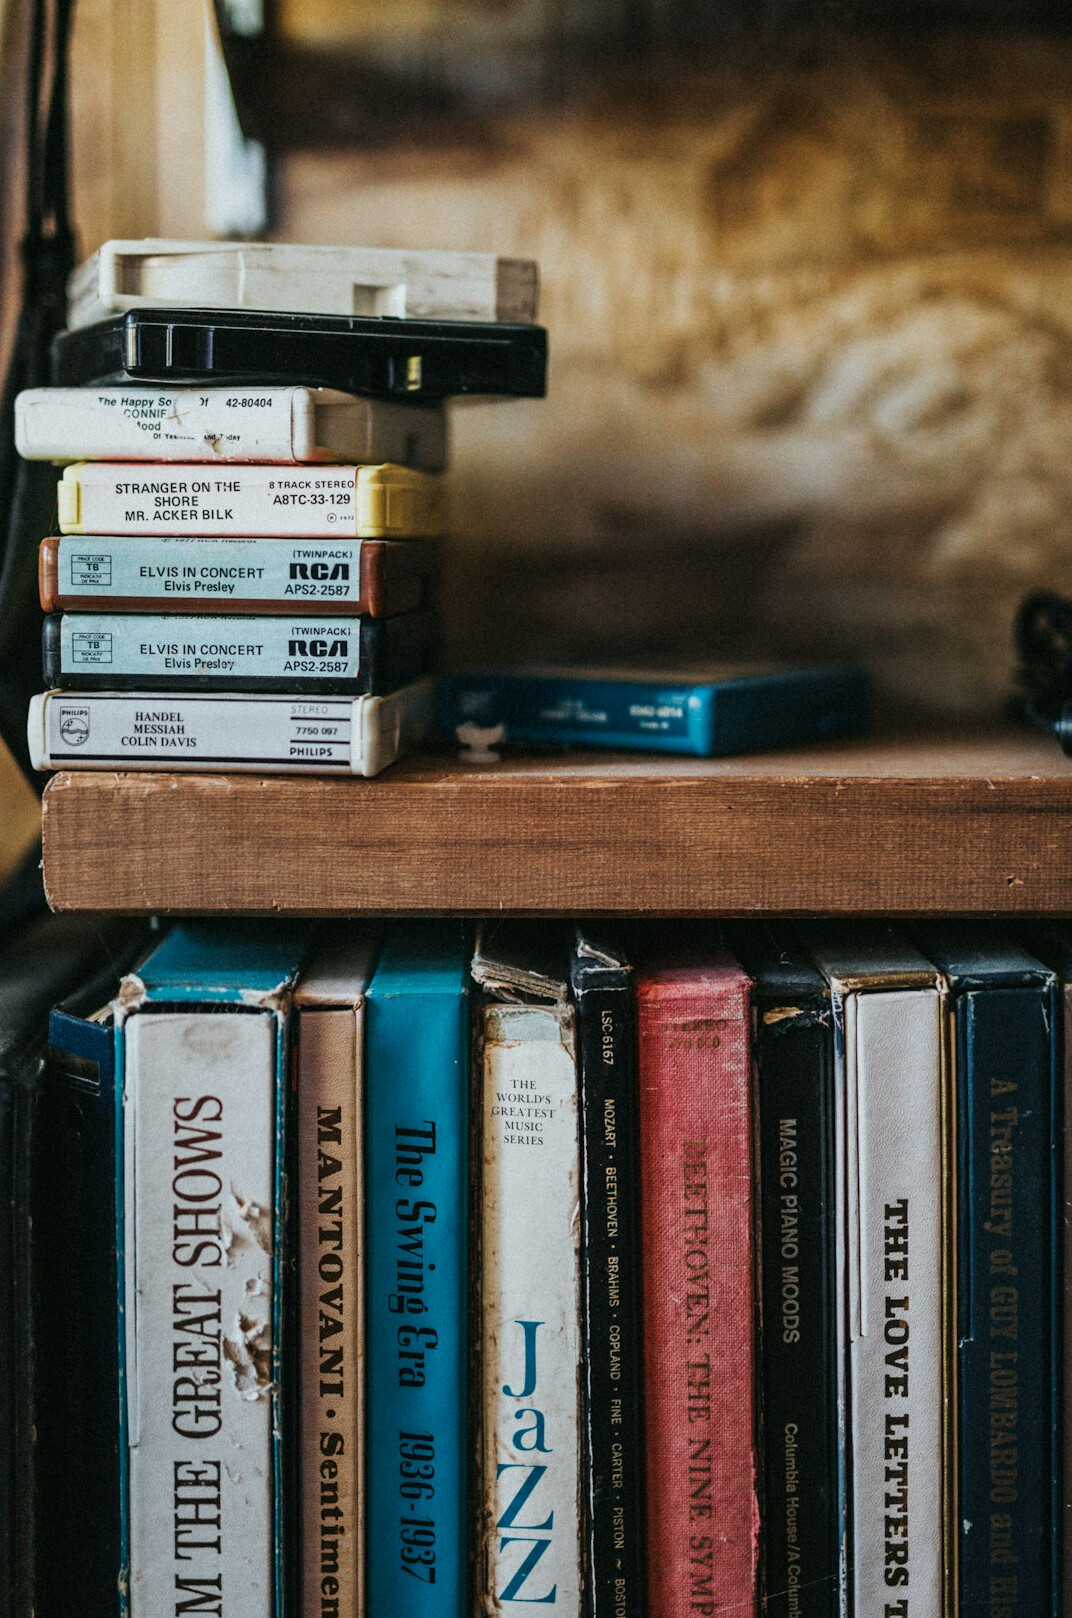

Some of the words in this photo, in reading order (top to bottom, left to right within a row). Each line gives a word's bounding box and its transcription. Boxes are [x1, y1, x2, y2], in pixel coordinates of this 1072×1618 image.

[98, 397, 117, 406] The
[121, 397, 155, 408] Happy
[226, 398, 273, 408] 42-80404
[115, 482, 187, 494] STRANGER
[191, 482, 211, 493] ON
[213, 481, 241, 493] THE
[269, 481, 275, 489] 8
[277, 481, 312, 489] TRACK
[314, 480, 355, 489] STEREO
[154, 496, 199, 507] SHORE
[273, 494, 351, 505] A8TC-33-129
[125, 509, 149, 521] MR.
[153, 509, 197, 521] ACKER
[201, 509, 234, 520] BILK
[86, 563, 99, 571] TB
[292, 550, 353, 559] (TWINPACK)
[139, 566, 178, 577] ELVIS
[183, 567, 196, 578] IN
[200, 567, 265, 579] CONCERT
[289, 562, 350, 580] RCA
[164, 580, 191, 592] Elvis
[194, 581, 235, 594] Presley
[284, 583, 350, 596] APS2-2587
[87, 641, 100, 649] TB
[291, 627, 351, 636] (TWINPACK)
[140, 643, 179, 655] ELVIS
[183, 644, 196, 655] IN
[200, 644, 264, 656] CONCERT
[288, 639, 348, 657] RCA
[164, 658, 191, 669] Elvis
[194, 658, 235, 671] Presley
[283, 660, 349, 673] APS2-2587
[135, 711, 185, 722] HANDEL
[290, 705, 329, 715] STEREO
[121, 736, 157, 747] COLIN
[160, 736, 197, 748] DAVIS
[133, 723, 185, 735] MESSIAH
[296, 727, 319, 735] 7750
[321, 727, 338, 736] 097
[290, 747, 333, 757] PHILIPS
[601, 1009, 615, 1066] LSC-6167
[510, 1079, 537, 1090] THE
[990, 1078, 1018, 1096] A
[496, 1092, 552, 1105] WORLD'S
[491, 1106, 557, 1119] GREATEST
[603, 1098, 617, 1148] MOZART
[504, 1120, 544, 1133] MUSIC
[395, 1121, 437, 1187] The
[503, 1135, 545, 1146] SERIES
[779, 1118, 799, 1188] MAGIC
[172, 1095, 224, 1268] SHOWS
[984, 1107, 1018, 1237] Treasury
[605, 1167, 619, 1238] BEETHOVEN
[780, 1194, 800, 1258] PIANO
[317, 1106, 344, 1398] MANTOVANI
[682, 1139, 711, 1344] BEETHOVEN:
[884, 1199, 910, 1281] THE
[389, 1199, 439, 1316] Swing
[990, 1248, 1018, 1276] of
[607, 1256, 621, 1308] BRAHMS
[781, 1266, 802, 1343] MOODS
[990, 1287, 1018, 1340] GUY
[398, 1325, 439, 1389] Era
[608, 1325, 622, 1381] COPLAND
[884, 1296, 910, 1397] LOVE
[173, 1284, 223, 1440] GREAT
[687, 1355, 713, 1424] THE
[610, 1399, 622, 1426] FINE
[991, 1350, 1020, 1503] LOMBARDO
[611, 1442, 624, 1490] CARTER
[783, 1422, 800, 1492] Columbia
[688, 1437, 714, 1522] NINE
[173, 1459, 222, 1561] THE
[399, 1431, 437, 1585] 1936-1937
[884, 1414, 910, 1587] LETTERS
[613, 1507, 625, 1550] PISTON
[990, 1512, 1020, 1565] and
[690, 1536, 717, 1617] SYMP
